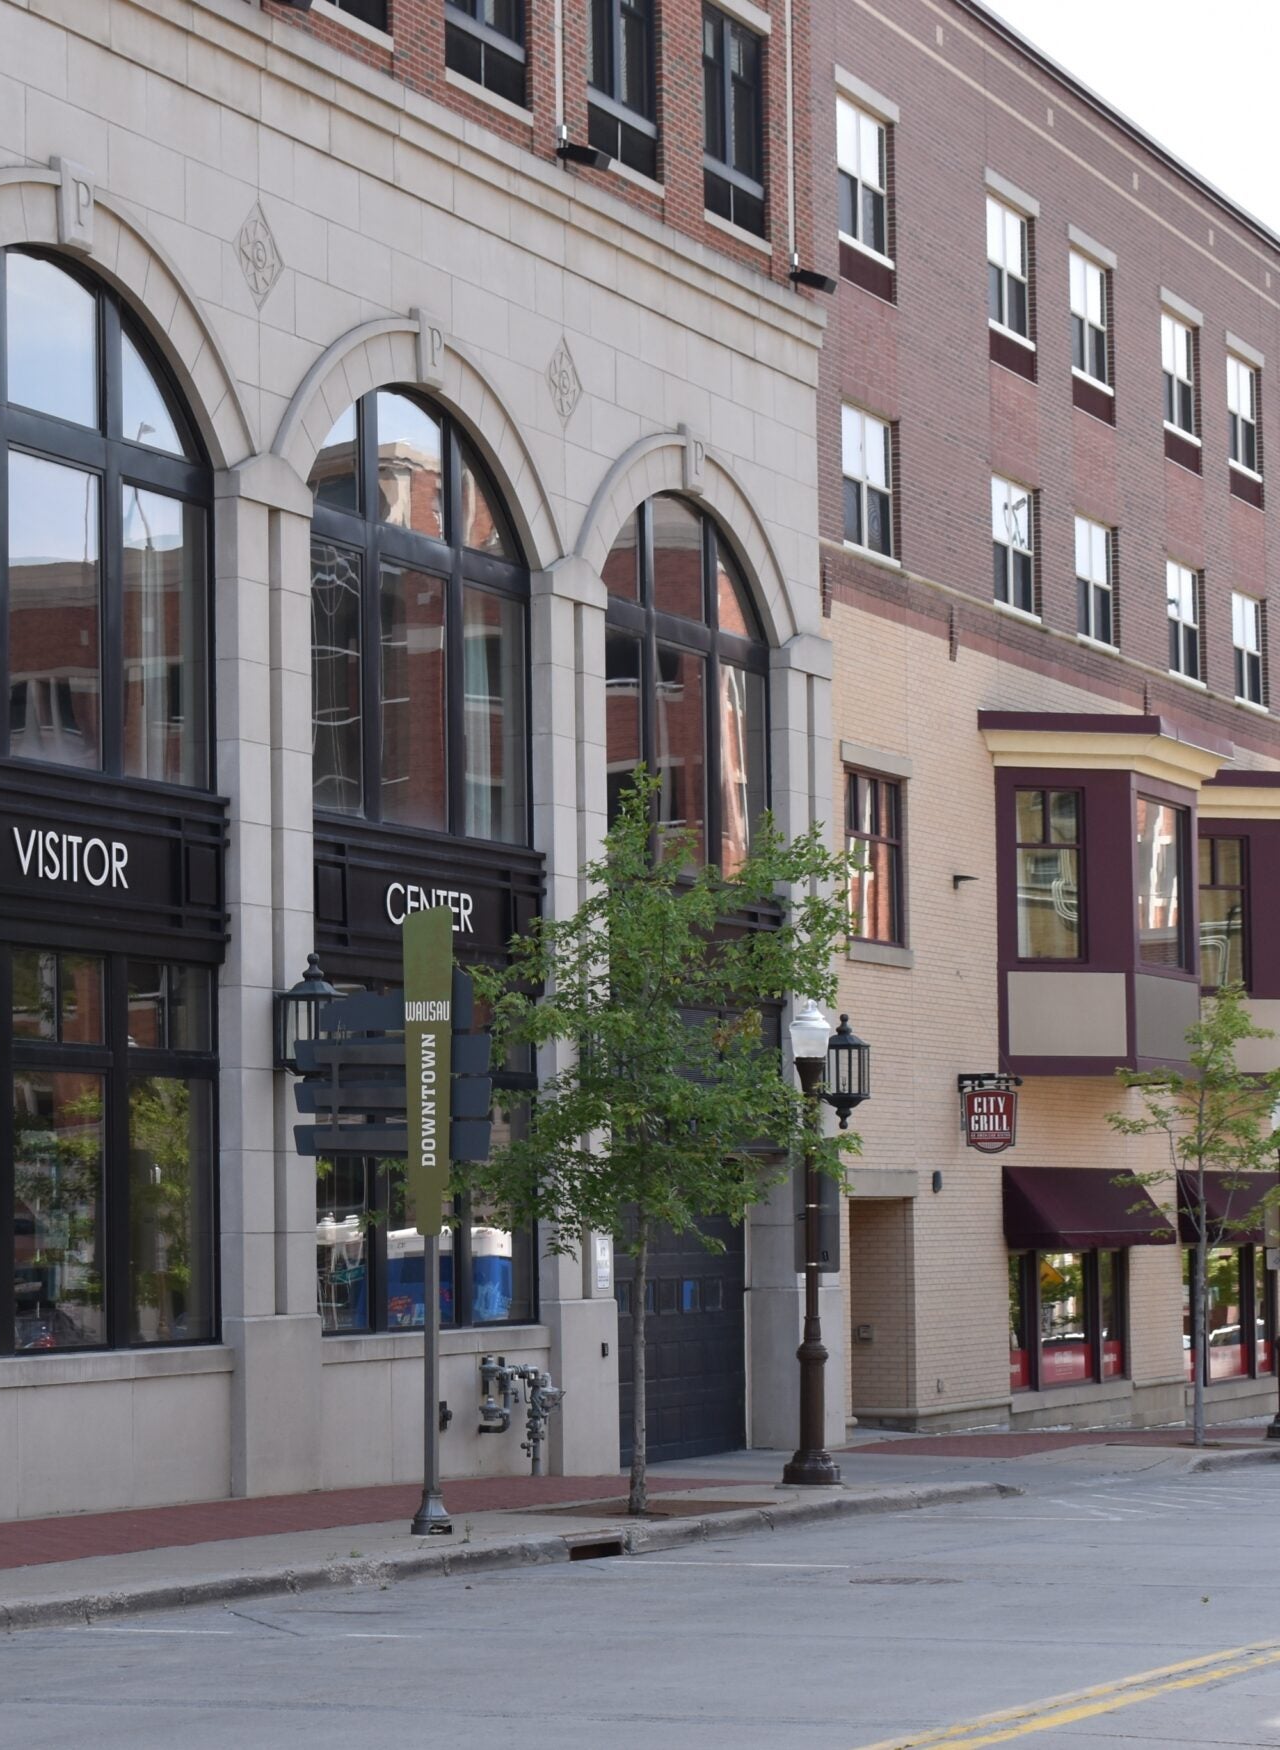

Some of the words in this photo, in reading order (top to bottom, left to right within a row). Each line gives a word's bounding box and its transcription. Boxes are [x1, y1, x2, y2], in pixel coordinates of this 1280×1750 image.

[72, 177, 91, 227] P
[427, 326, 442, 368] P
[12, 826, 129, 889] VISITOR
[405, 1000, 450, 1022] WAUSAU
[421, 1033, 436, 1167] DOWNTOWN
[973, 1096, 1006, 1114] CITY
[971, 1114, 1010, 1131] GRILL
